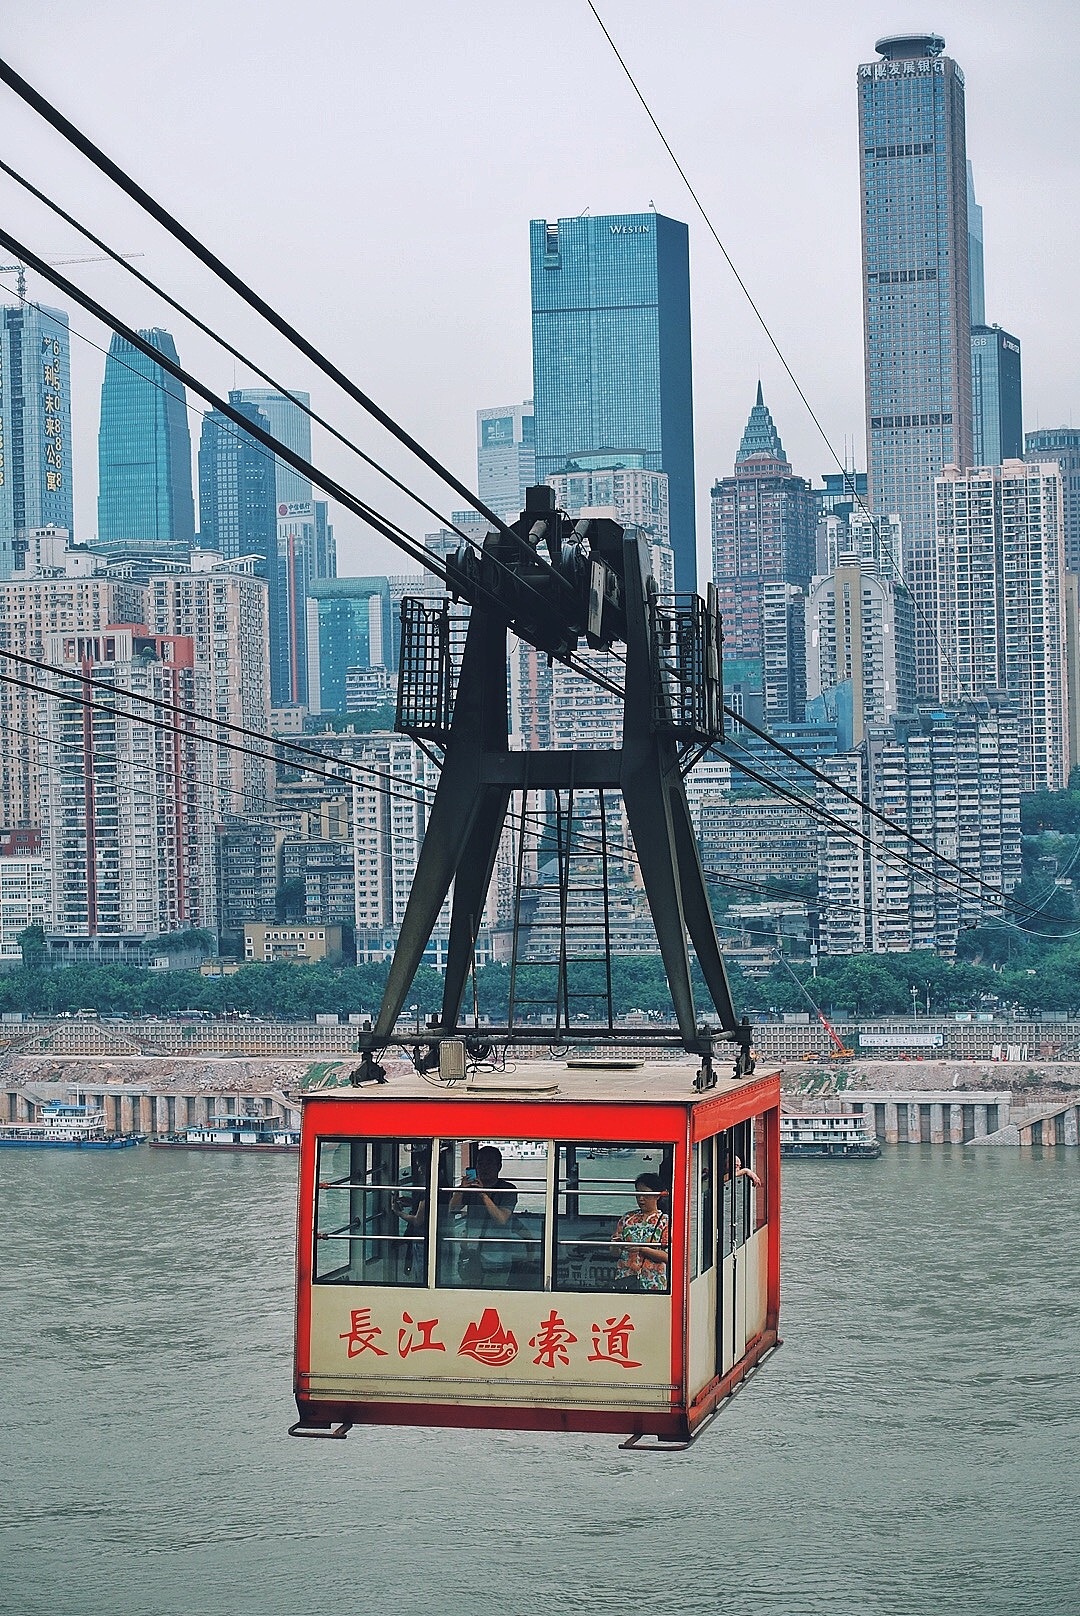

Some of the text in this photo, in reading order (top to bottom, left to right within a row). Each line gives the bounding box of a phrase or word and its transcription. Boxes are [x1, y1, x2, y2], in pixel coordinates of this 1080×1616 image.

[860, 60, 945, 79] 农业发展银行
[610, 225, 649, 234] WESTIN
[971, 337, 987, 347] GB
[339, 1308, 643, 1369] 長江 索道
